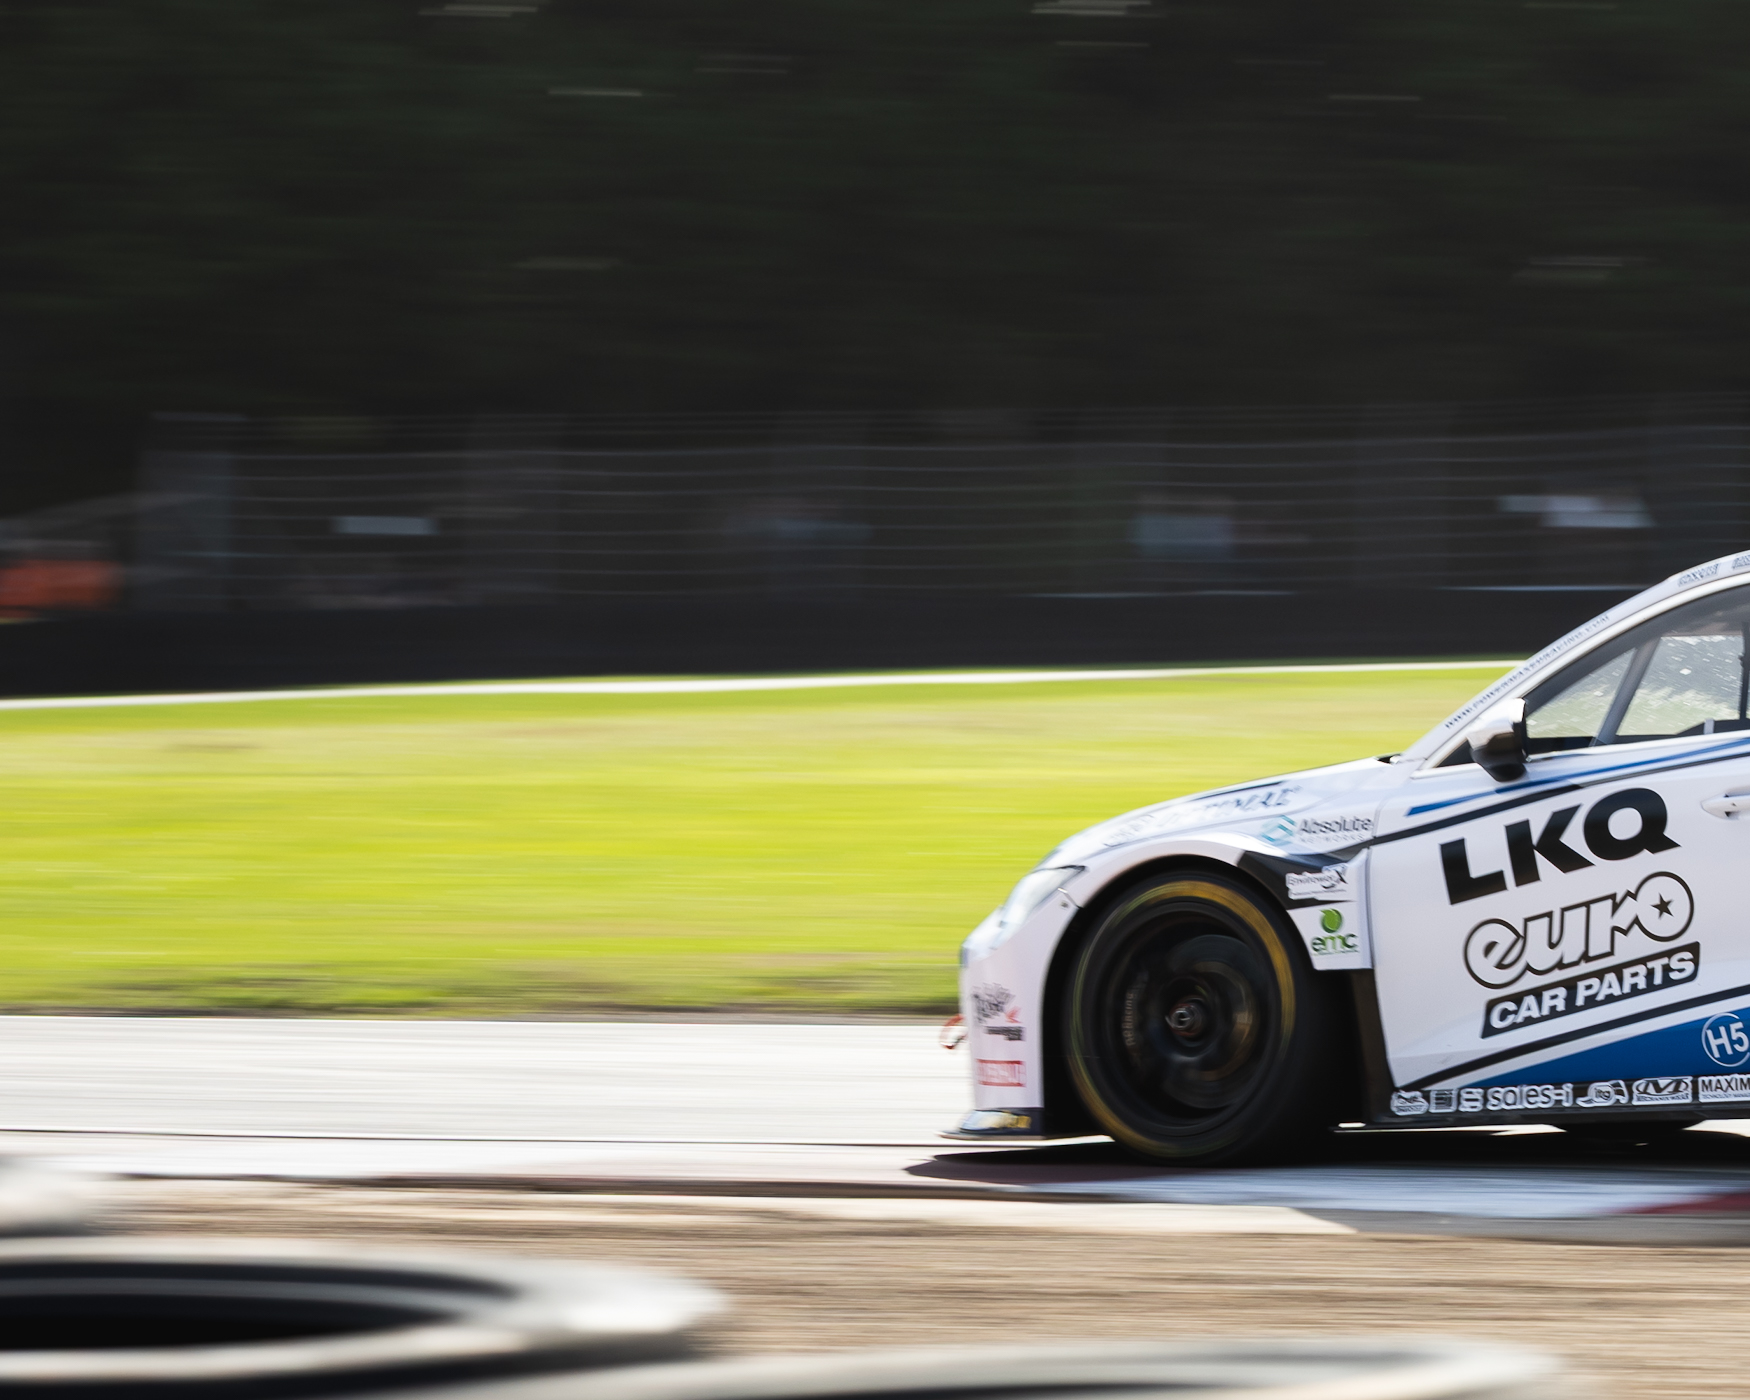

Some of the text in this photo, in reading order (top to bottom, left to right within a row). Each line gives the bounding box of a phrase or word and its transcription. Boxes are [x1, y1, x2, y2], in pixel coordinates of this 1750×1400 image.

[1300, 816, 1372, 834] Absolute
[1439, 787, 1682, 905] LKQ
[1312, 933, 1358, 952] emc
[1463, 871, 1694, 990] euro
[1489, 951, 1695, 1030] CAR PARTS
[1706, 1021, 1750, 1059] H5
[1487, 1083, 1573, 1111] sales-i
